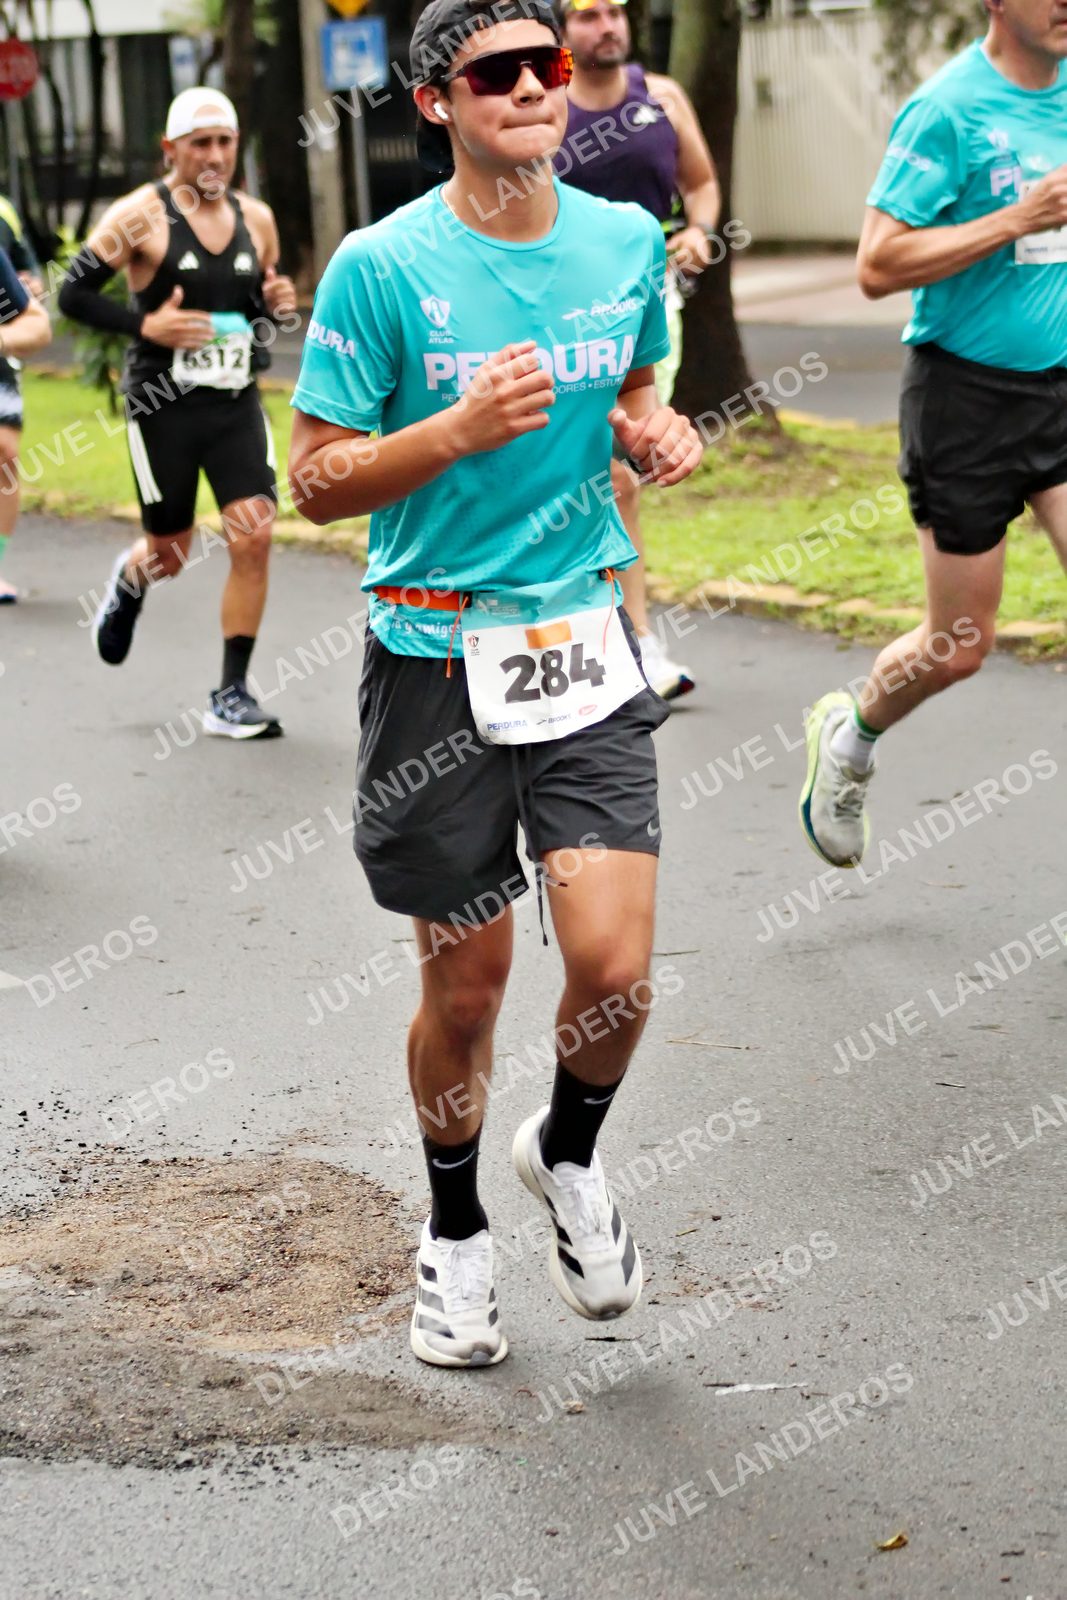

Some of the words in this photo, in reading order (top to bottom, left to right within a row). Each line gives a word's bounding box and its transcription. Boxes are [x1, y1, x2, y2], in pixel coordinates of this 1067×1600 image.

[423, 334, 637, 393] PEURA
[499, 642, 607, 705] 284
[486, 719, 529, 732] PERDURA
